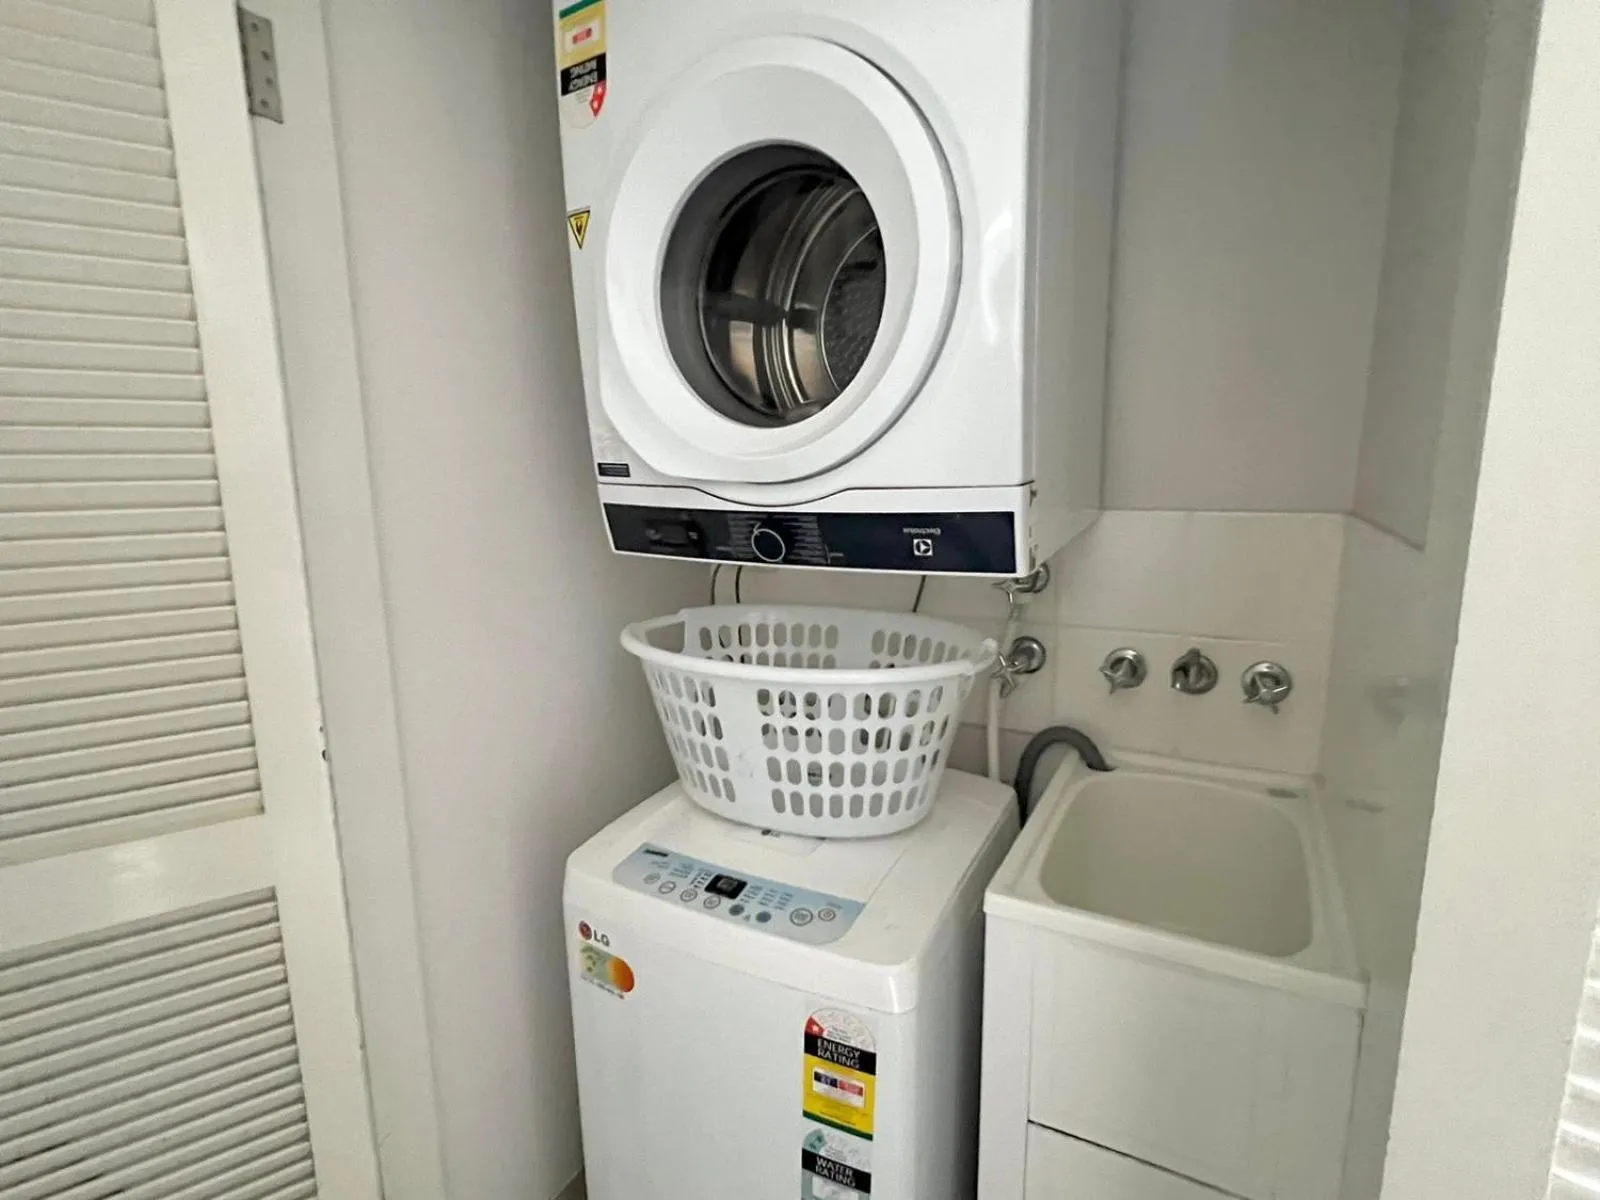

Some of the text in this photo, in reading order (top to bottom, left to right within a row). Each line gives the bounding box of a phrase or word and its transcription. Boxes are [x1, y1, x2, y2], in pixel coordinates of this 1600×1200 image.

[593, 928, 610, 947] LG
[817, 1038, 861, 1059] ENERGY
[817, 1051, 860, 1069] RATING
[815, 1166, 856, 1187] RATING
[816, 1156, 854, 1177] WATER
